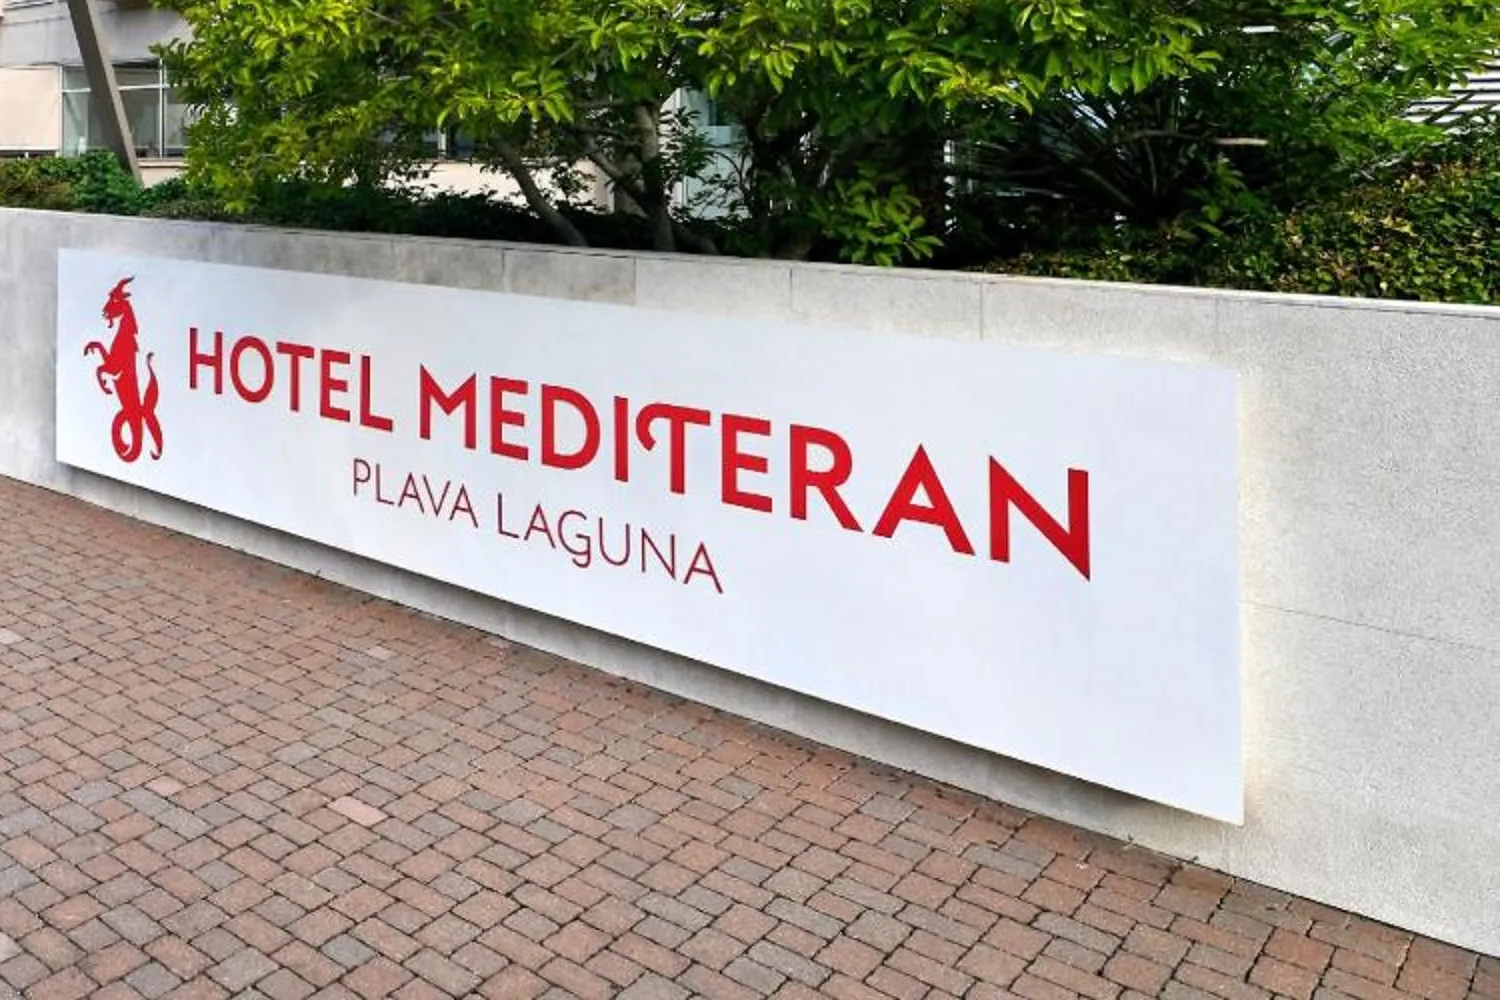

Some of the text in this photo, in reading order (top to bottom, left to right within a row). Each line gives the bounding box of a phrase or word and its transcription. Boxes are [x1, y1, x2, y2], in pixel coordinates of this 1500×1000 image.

[188, 327, 1092, 580] HOTEL MEDITERAN
[352, 458, 724, 594] PLAVA LAGUNA
